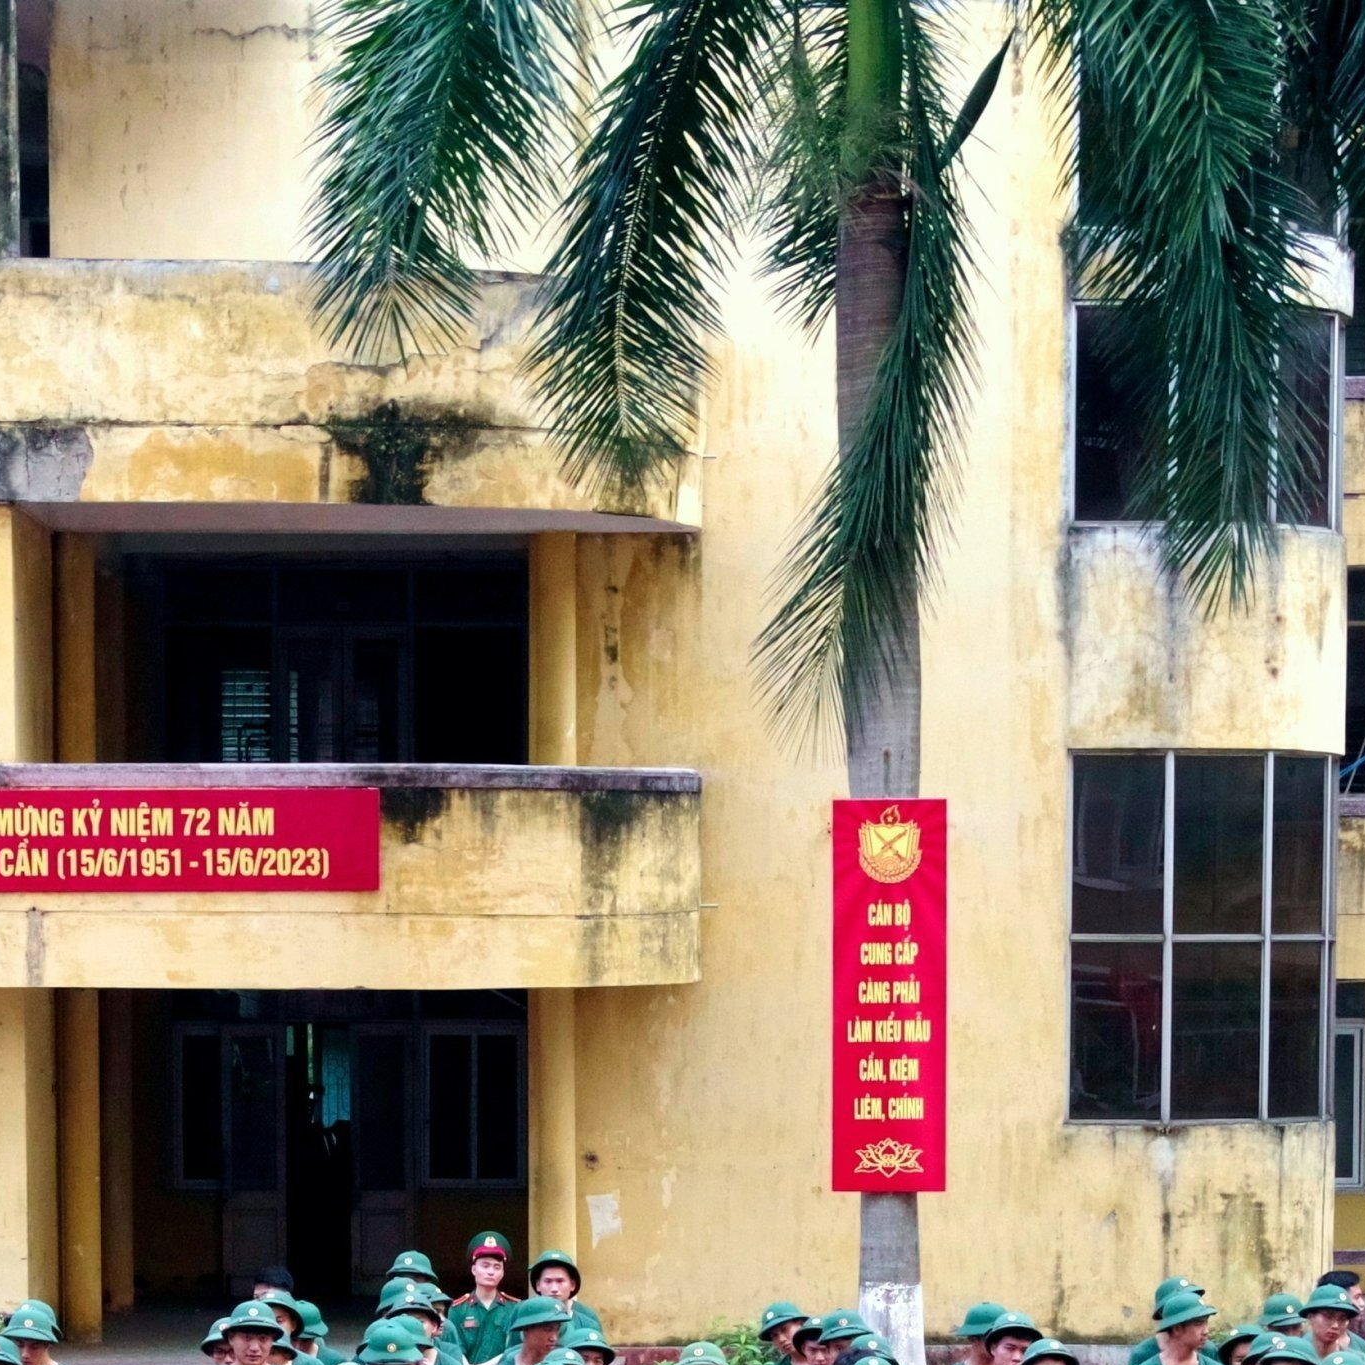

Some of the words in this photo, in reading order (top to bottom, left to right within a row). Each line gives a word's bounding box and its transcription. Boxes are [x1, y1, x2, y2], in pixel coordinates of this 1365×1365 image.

[73, 799, 102, 837] KỶ
[111, 802, 173, 843] NIỆM
[181, 808, 210, 837] 72
[218, 801, 274, 837] NĂM
[0, 838, 48, 877] CẦN
[58, 848, 182, 880] (15/6/1951
[867, 898, 892, 927] CÁN
[894, 898, 911, 931] BỘ
[860, 942, 892, 966] CUNG
[895, 934, 919, 965] CẤP
[858, 976, 890, 1004] CÀNG
[892, 973, 921, 1004] PHẢI
[847, 1015, 872, 1043] LÀM
[875, 1010, 902, 1043] KIỂU
[904, 1011, 931, 1043] MẪU
[889, 1054, 919, 1086] KIỆM
[854, 1092, 886, 1122] LIÊM,
[888, 1092, 924, 1120] CHÍNH
